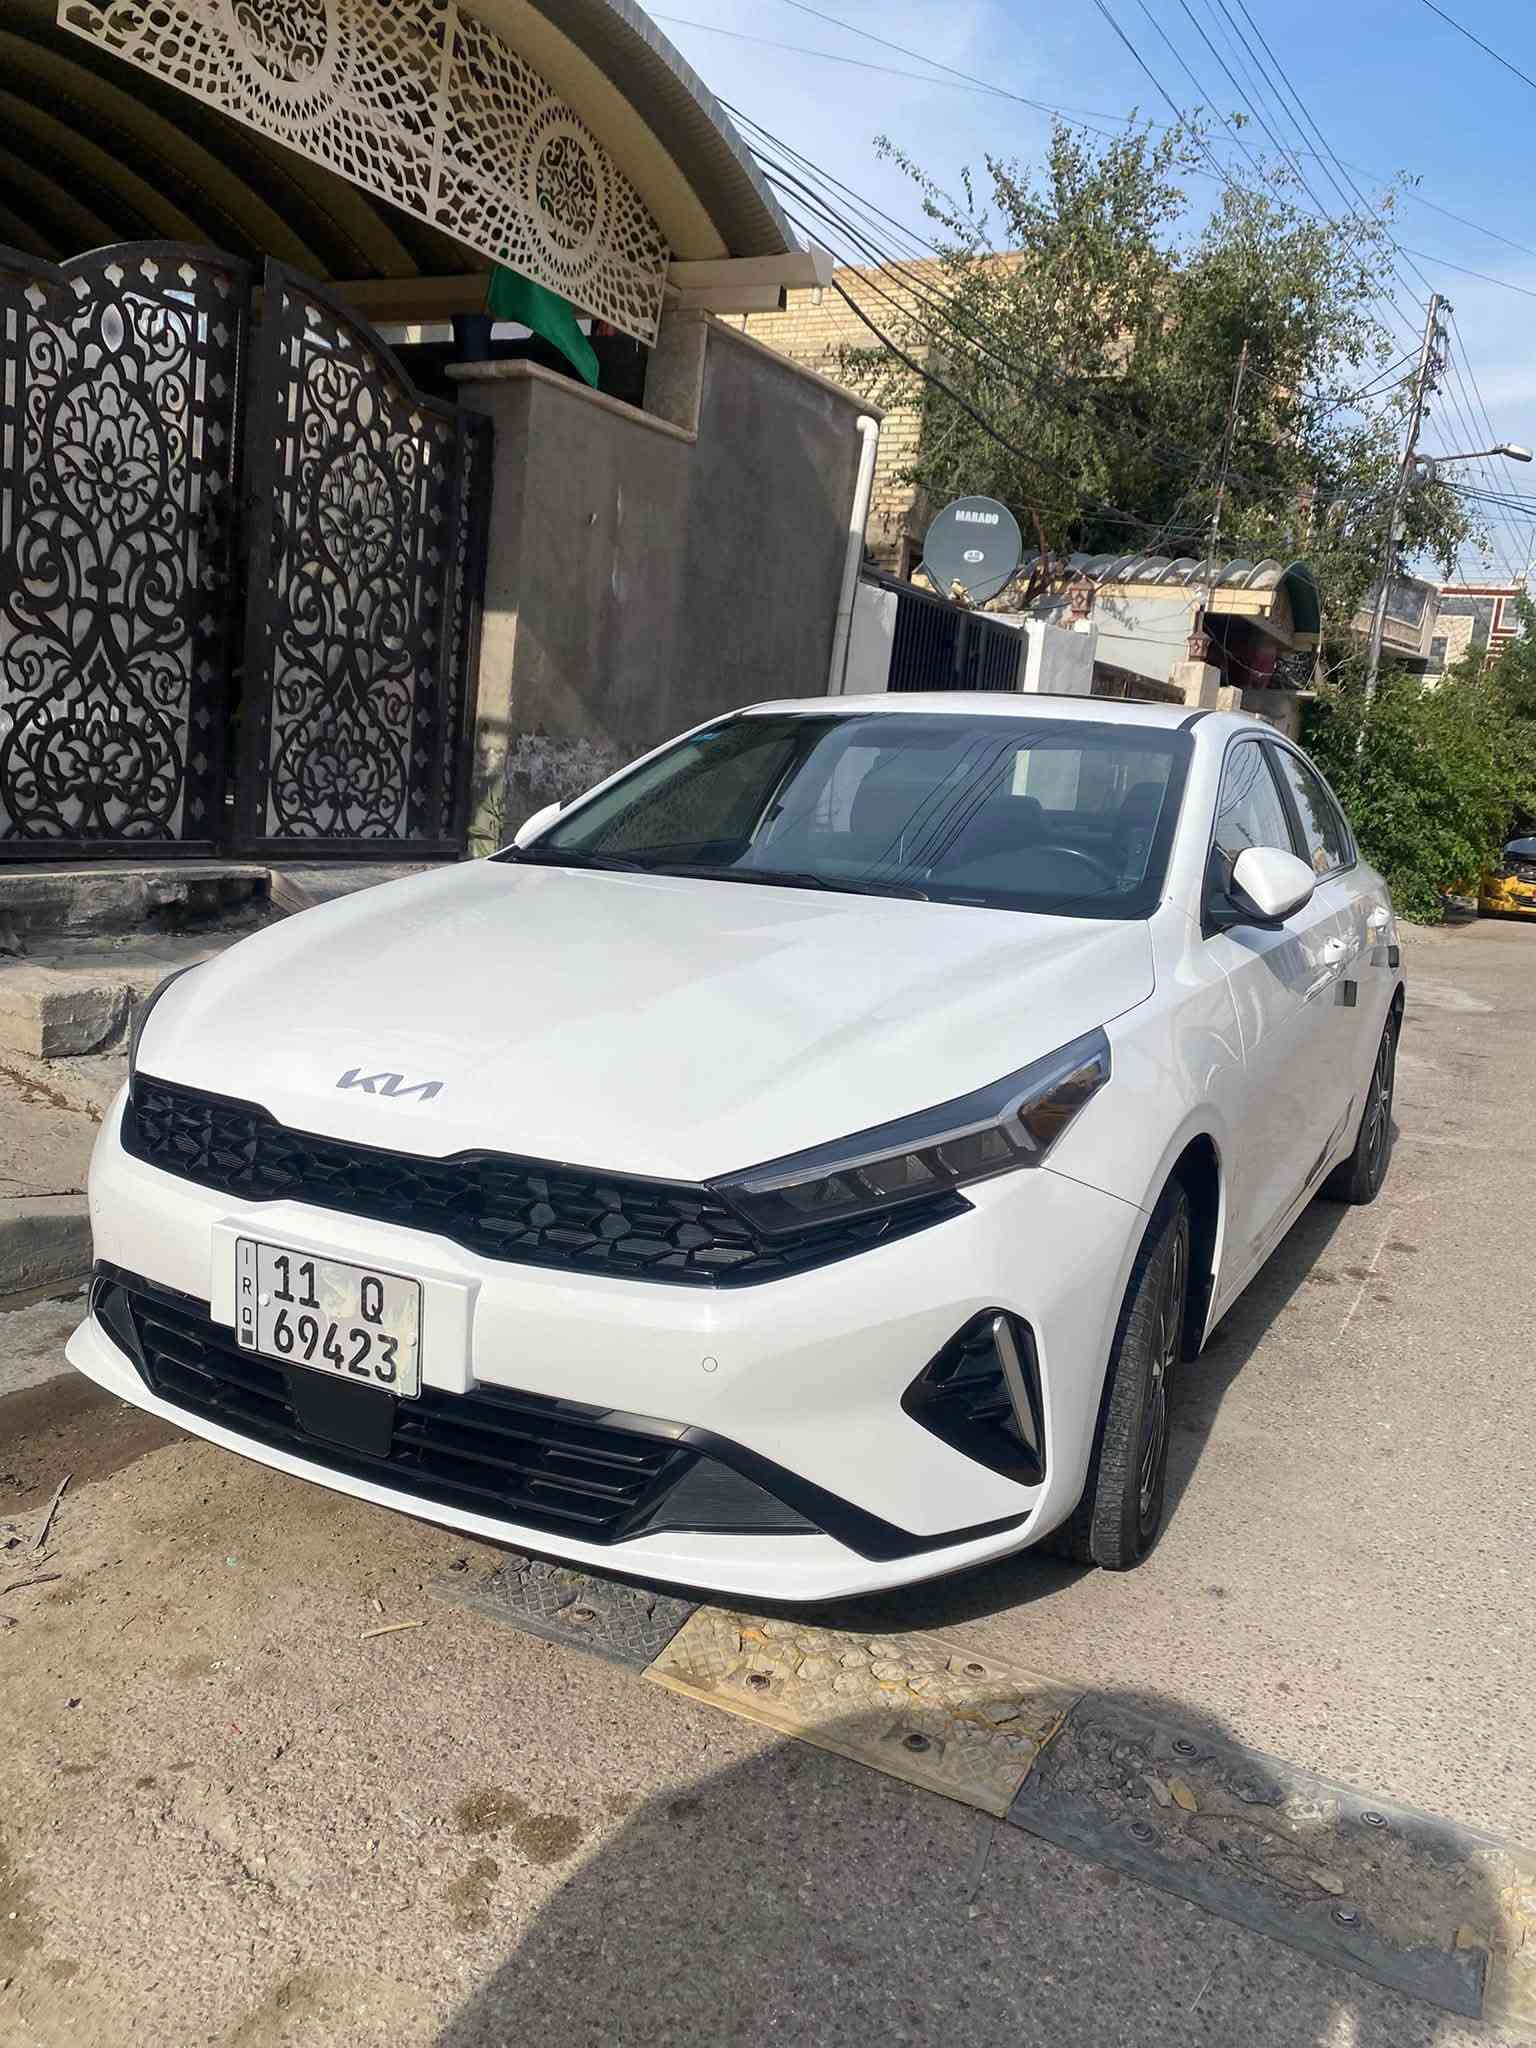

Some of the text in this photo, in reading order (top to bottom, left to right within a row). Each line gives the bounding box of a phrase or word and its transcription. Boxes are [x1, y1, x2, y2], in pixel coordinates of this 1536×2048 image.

[273, 1255, 384, 1325] 11 Q
[273, 1308, 399, 1384] 69423
